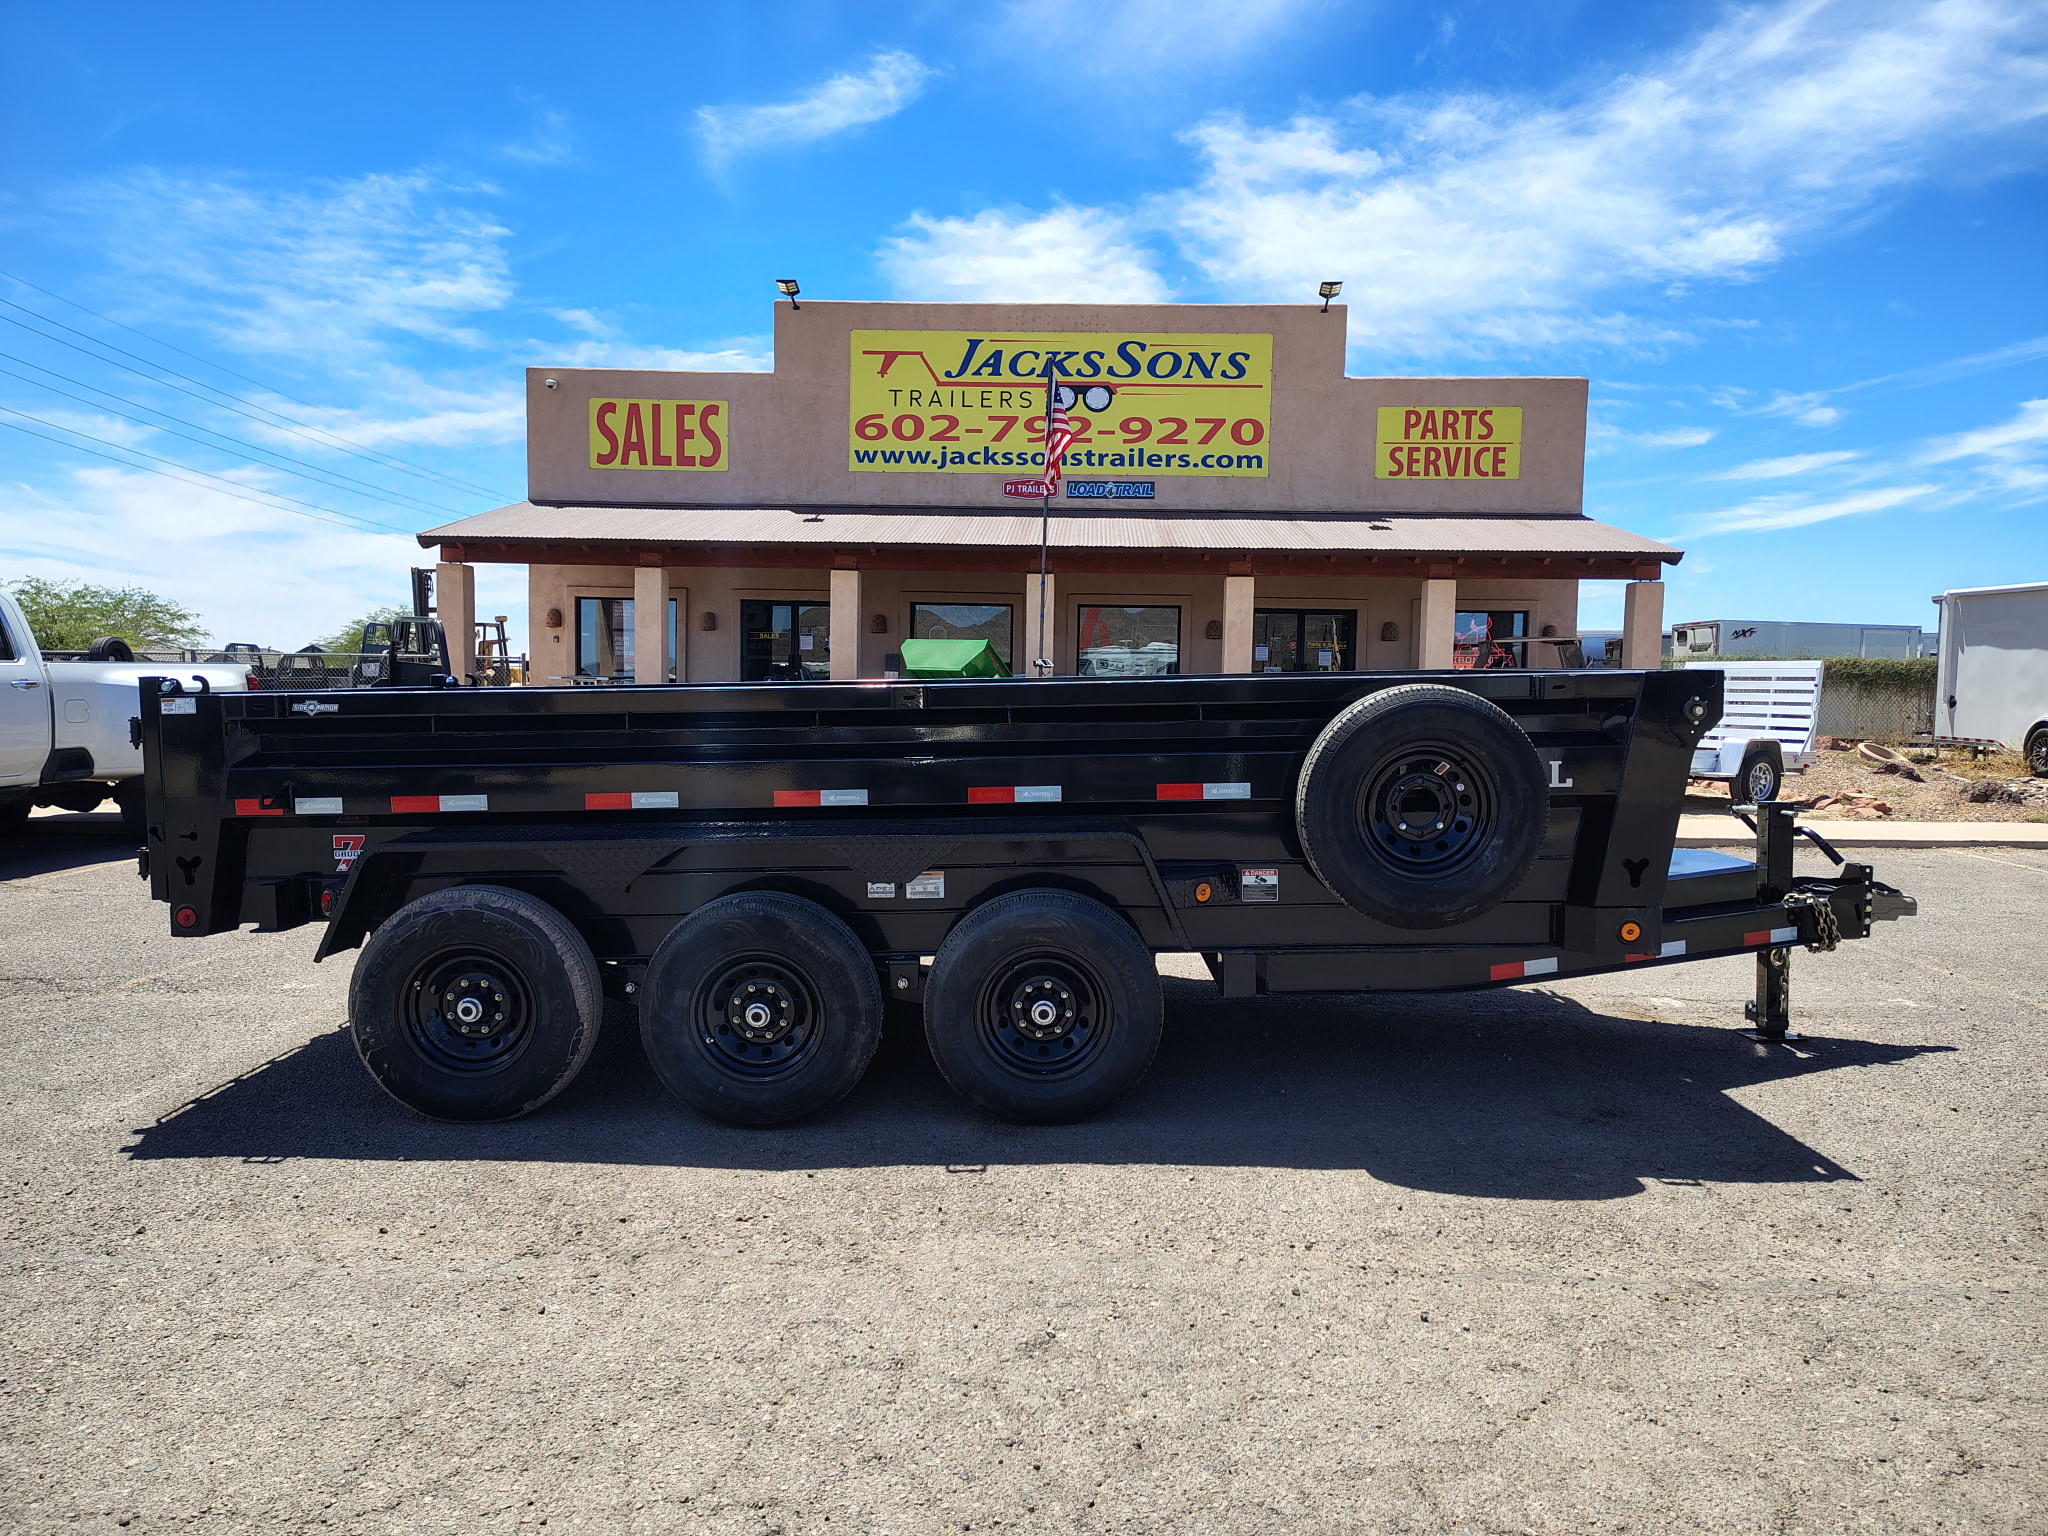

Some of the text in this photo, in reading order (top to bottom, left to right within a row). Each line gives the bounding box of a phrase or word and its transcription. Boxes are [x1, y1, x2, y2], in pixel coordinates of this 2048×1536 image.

[888, 388, 1033, 409] TRAILERS
[596, 401, 722, 468] SALES
[854, 413, 1265, 446] 602-792-9270
[1403, 409, 1494, 441] PARTS
[1388, 446, 1507, 477] SERVICE
[1006, 484, 1055, 493] PJ TRAILES
[1068, 482, 1155, 498] LOAD TRAIL
[333, 834, 365, 872] 7
